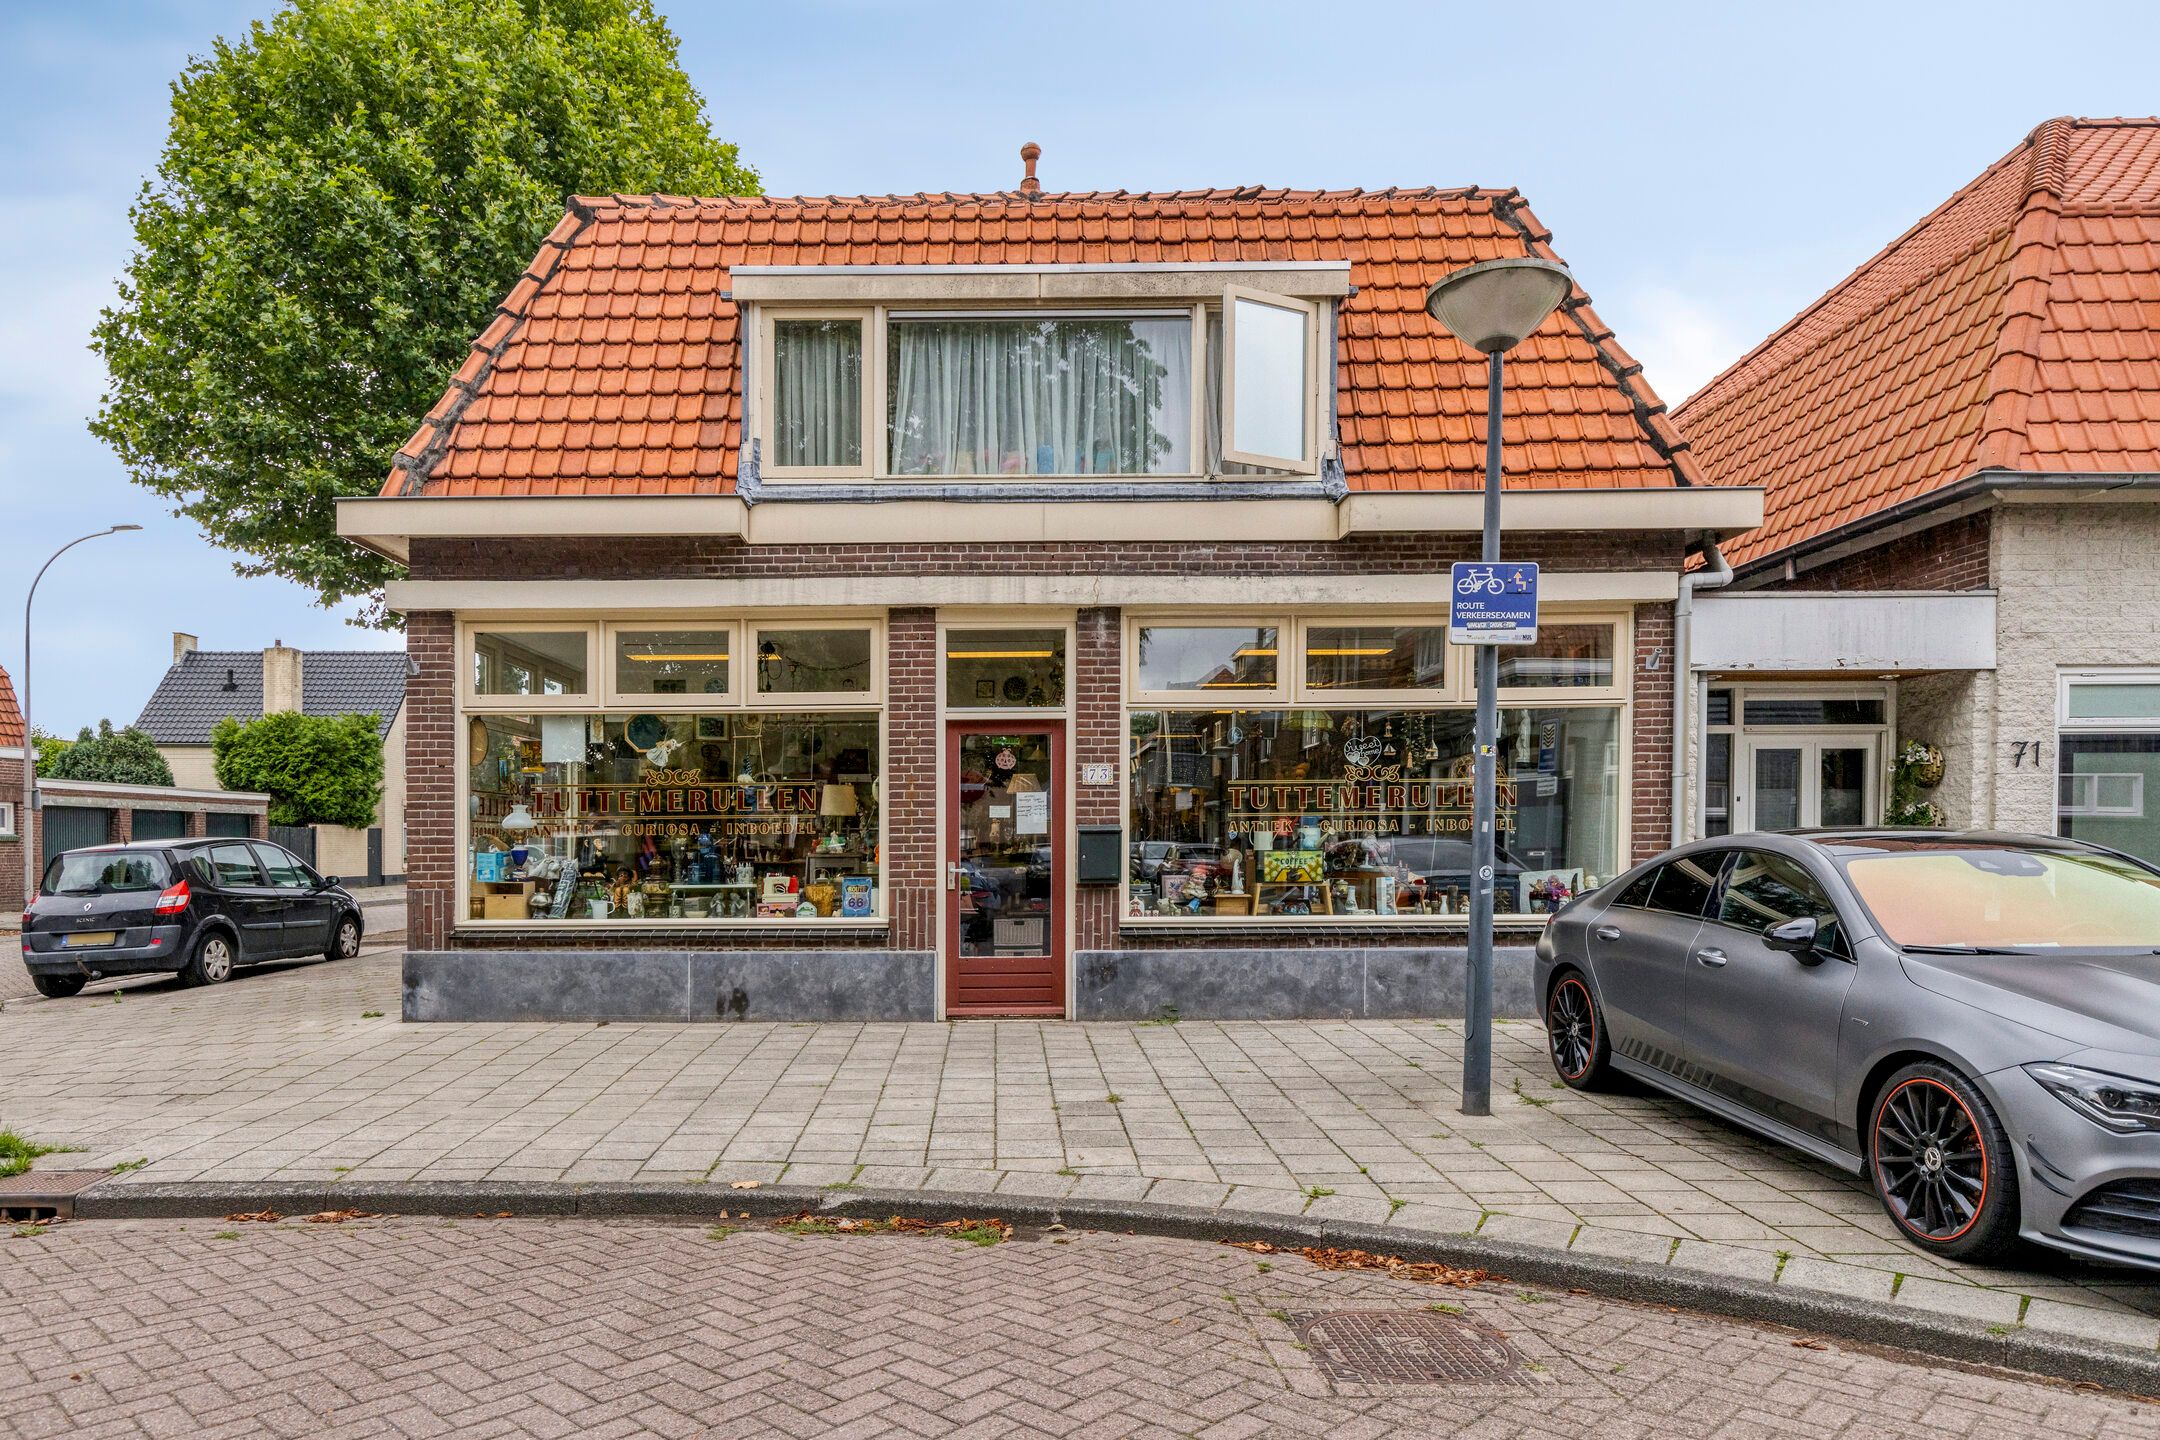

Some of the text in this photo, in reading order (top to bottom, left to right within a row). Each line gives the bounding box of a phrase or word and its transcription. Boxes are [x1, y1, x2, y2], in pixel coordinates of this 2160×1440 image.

[1456, 611, 1531, 619] VERKEERSEXAMEN
[2011, 741, 2040, 768] 71
[1089, 768, 1108, 780] 73
[531, 789, 816, 812] TUTTEMERULLEN
[1228, 785, 1517, 809] TUTTEMERULLN
[531, 825, 595, 837] ANTIEK
[622, 823, 700, 836] CURIOSA
[727, 822, 816, 835] INBOEDEL
[1228, 820, 1293, 833] ANTIEK
[1320, 819, 1399, 832] CURIOSA
[1426, 818, 1517, 832] INBOEL
[1280, 858, 1308, 866] COFFEE
[848, 898, 864, 908] 66
